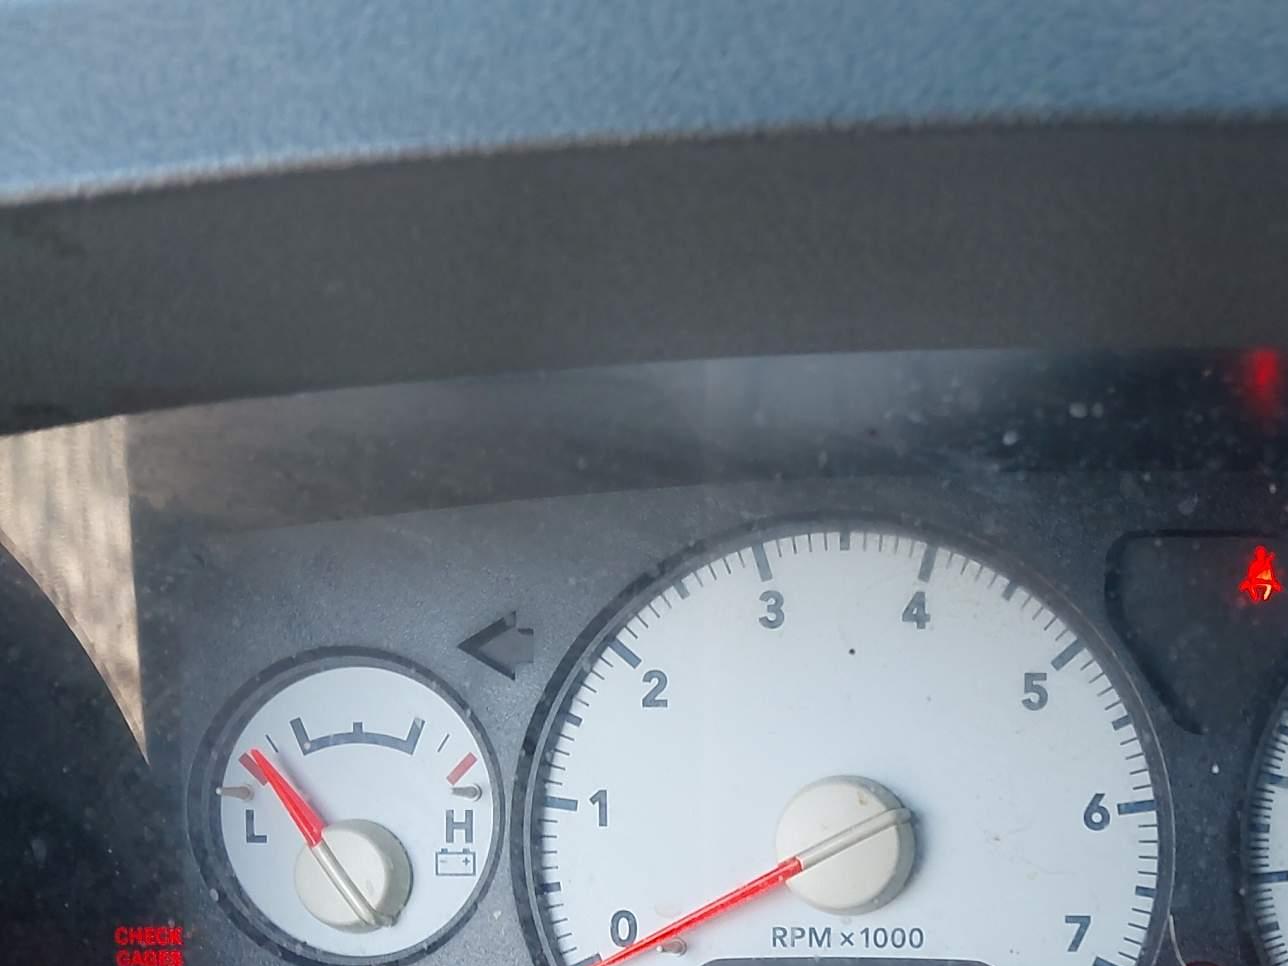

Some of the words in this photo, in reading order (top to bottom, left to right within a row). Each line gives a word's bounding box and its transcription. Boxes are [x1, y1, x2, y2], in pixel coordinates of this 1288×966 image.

[759, 592, 786, 630] 3
[902, 592, 930, 630] 4
[641, 670, 668, 708] 2
[1022, 673, 1047, 711] 5
[245, 809, 268, 843] L
[445, 809, 473, 843] H
[589, 790, 609, 827] 1
[1083, 793, 1110, 831] 6
[114, 926, 184, 946] CHECK
[610, 910, 638, 947] 0
[772, 928, 831, 949] RPM
[1064, 915, 1092, 952] 7
